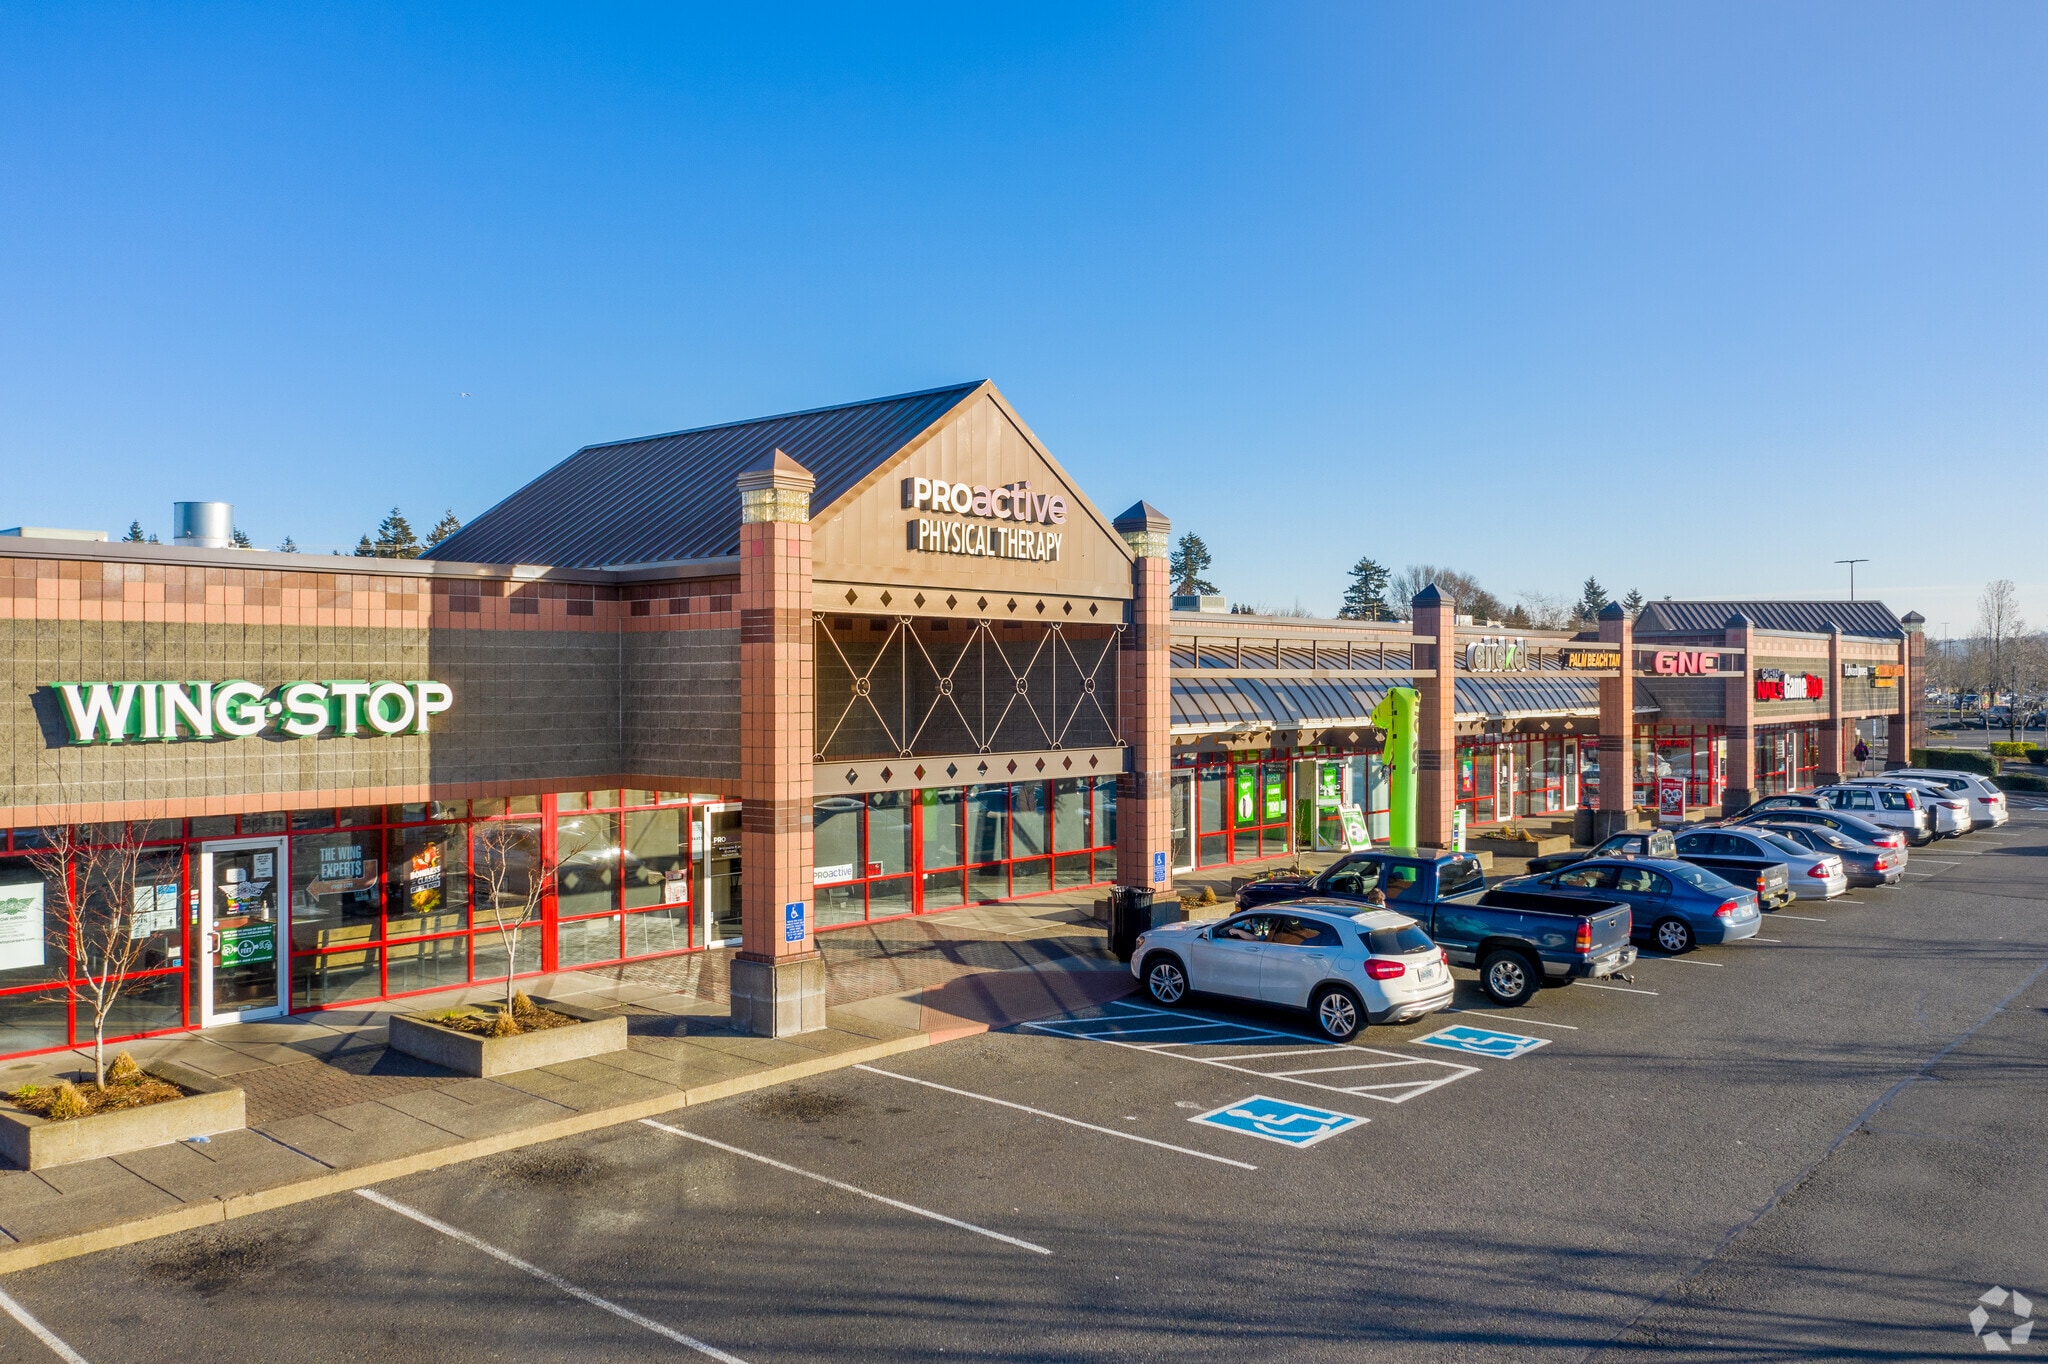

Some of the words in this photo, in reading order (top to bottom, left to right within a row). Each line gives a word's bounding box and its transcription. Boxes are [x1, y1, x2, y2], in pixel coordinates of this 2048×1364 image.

[913, 477, 1068, 525] PROactive
[918, 518, 996, 556] PHYSICAL
[998, 527, 1063, 562] THERAPY
[1568, 652, 1588, 668] PALM
[1587, 652, 1611, 667] BEACH
[1609, 652, 1621, 667] TAN
[1655, 651, 1719, 674] GNC
[1757, 681, 1784, 701] NAILS
[1784, 673, 1823, 700] GameStop
[320, 847, 336, 862] THE
[338, 845, 362, 860] WING
[321, 861, 362, 879] EXPERTS
